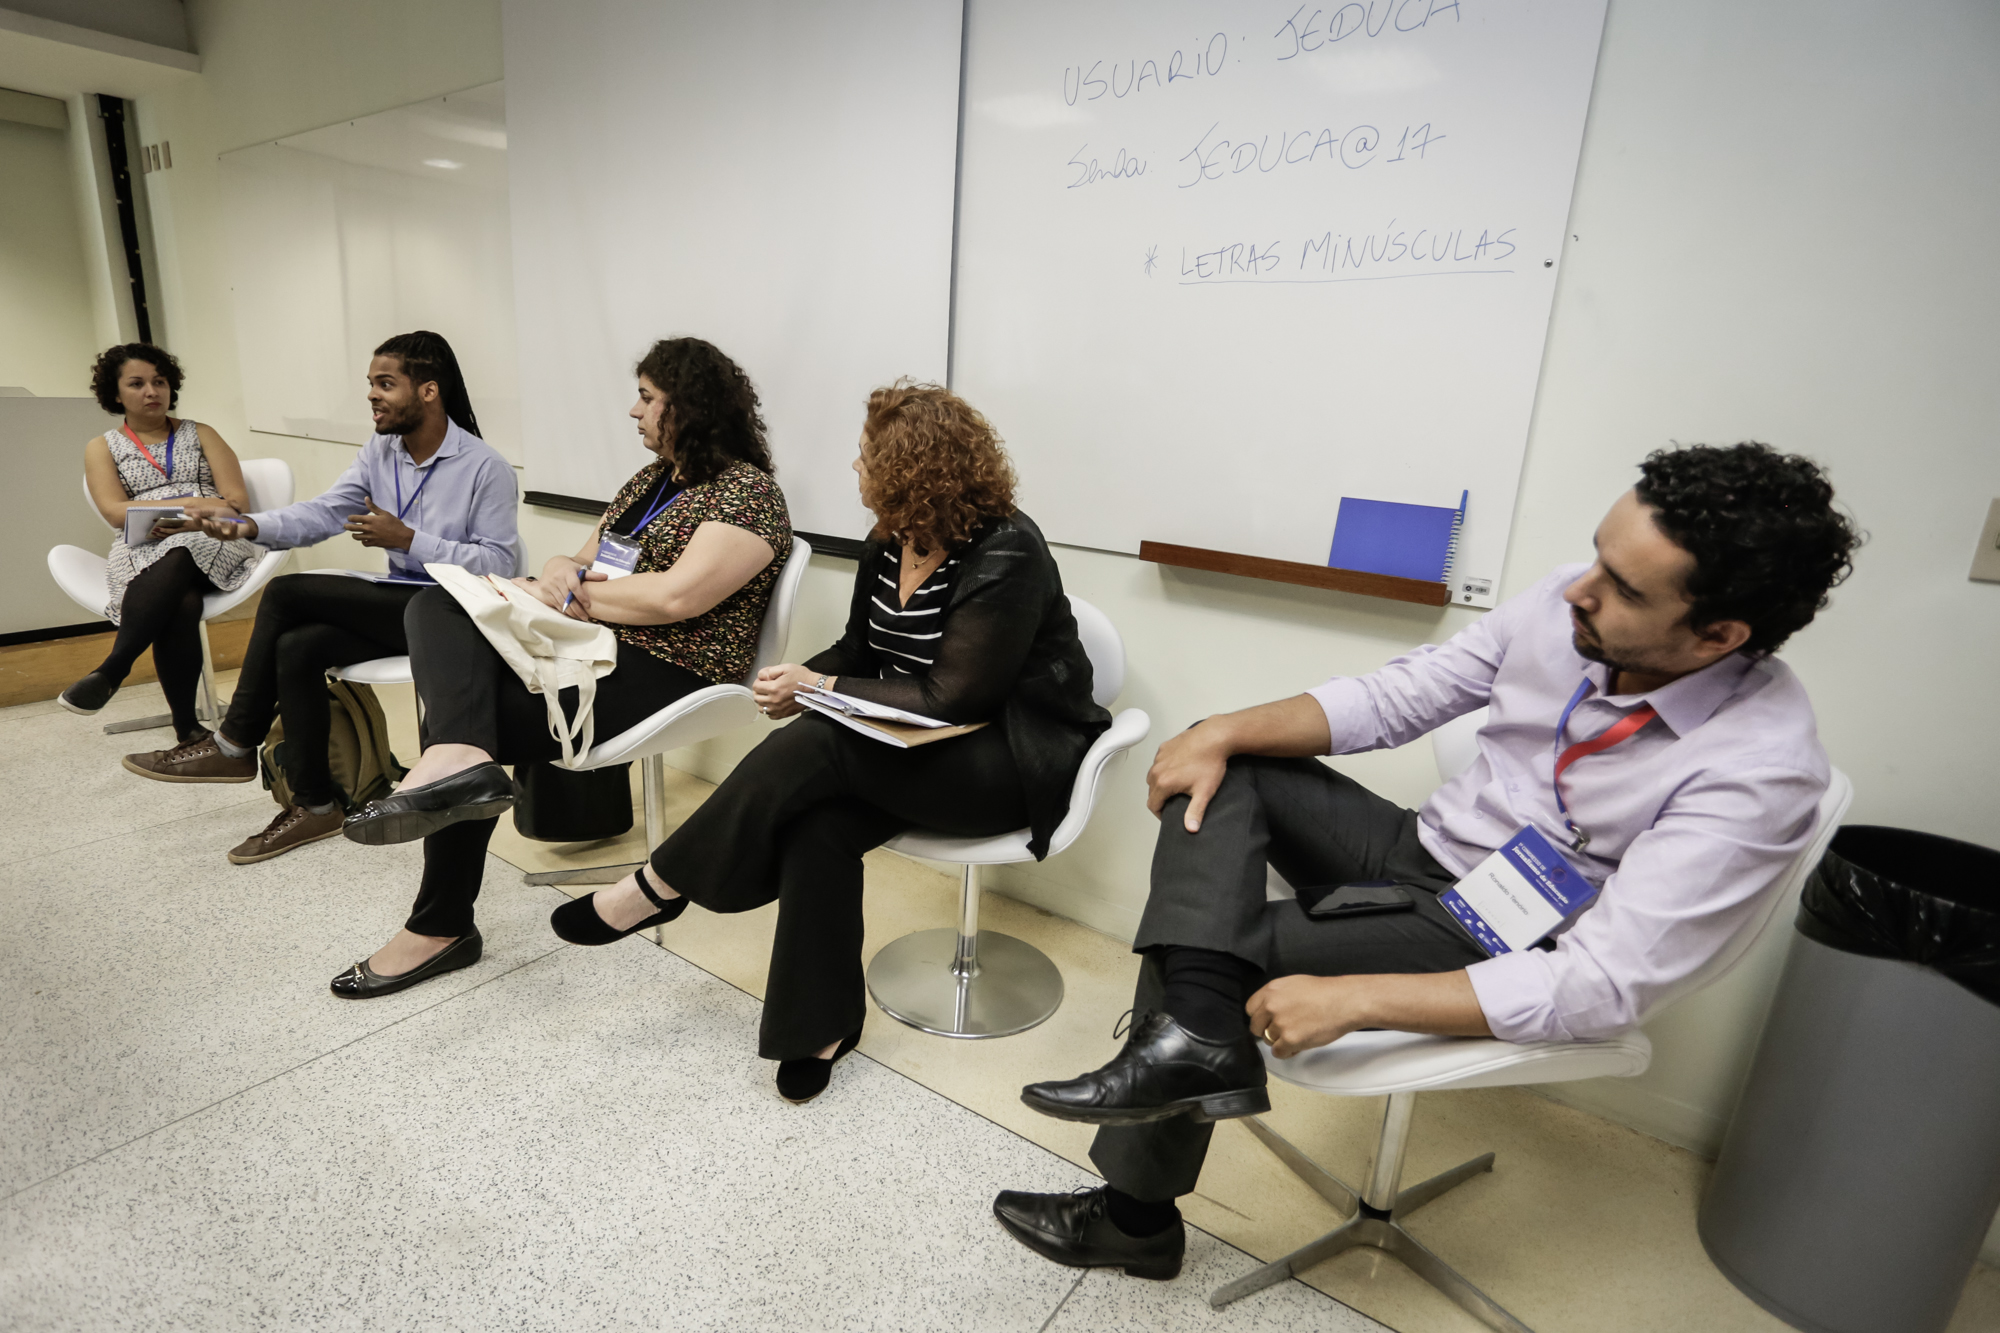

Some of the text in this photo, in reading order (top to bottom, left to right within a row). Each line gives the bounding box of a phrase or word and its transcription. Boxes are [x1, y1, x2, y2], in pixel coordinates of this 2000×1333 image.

[1181, 217, 1517, 278] LETRAS MINÚSCULAS
[1488, 872, 1510, 896] Ronaldo
[1510, 894, 1529, 916] Tenório
[1511, 845, 1541, 876] Jornalismo
[1545, 880, 1569, 905] Educação
